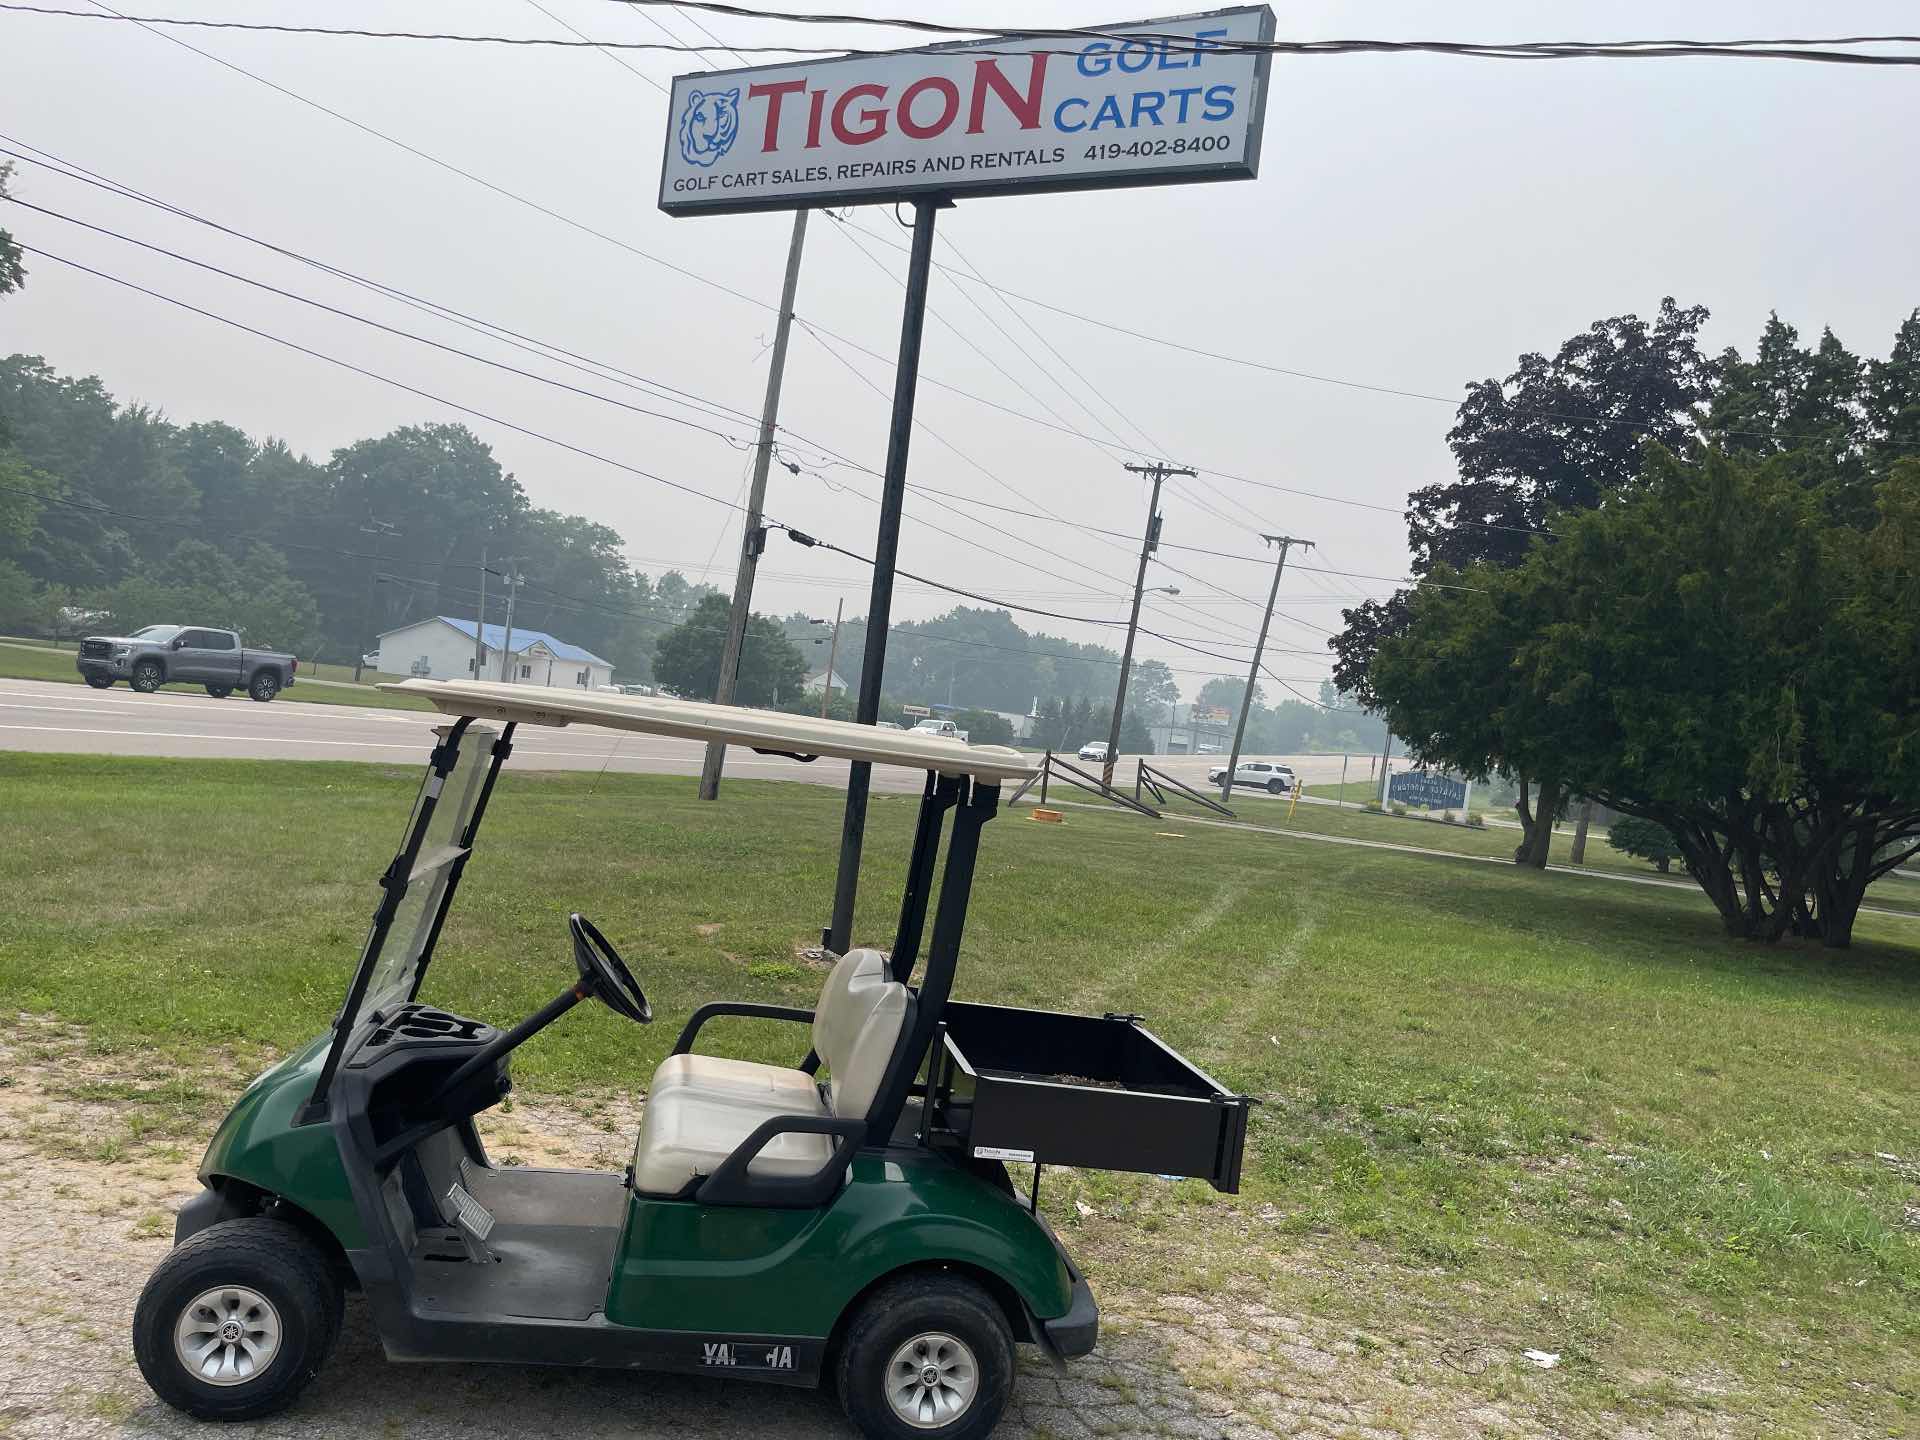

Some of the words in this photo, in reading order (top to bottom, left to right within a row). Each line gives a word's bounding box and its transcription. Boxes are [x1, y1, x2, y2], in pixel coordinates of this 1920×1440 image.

[1076, 28, 1228, 78] GOLF
[748, 52, 1048, 152] TIGON
[1053, 85, 1237, 134] CARTS
[673, 176, 719, 192] GOLF
[721, 171, 768, 188] CART
[771, 166, 832, 184] SALES,
[837, 159, 916, 180] REPAIRS
[922, 156, 965, 172] AND
[970, 147, 1065, 169] RENTALS
[1083, 135, 1231, 161] 419-402-8400
